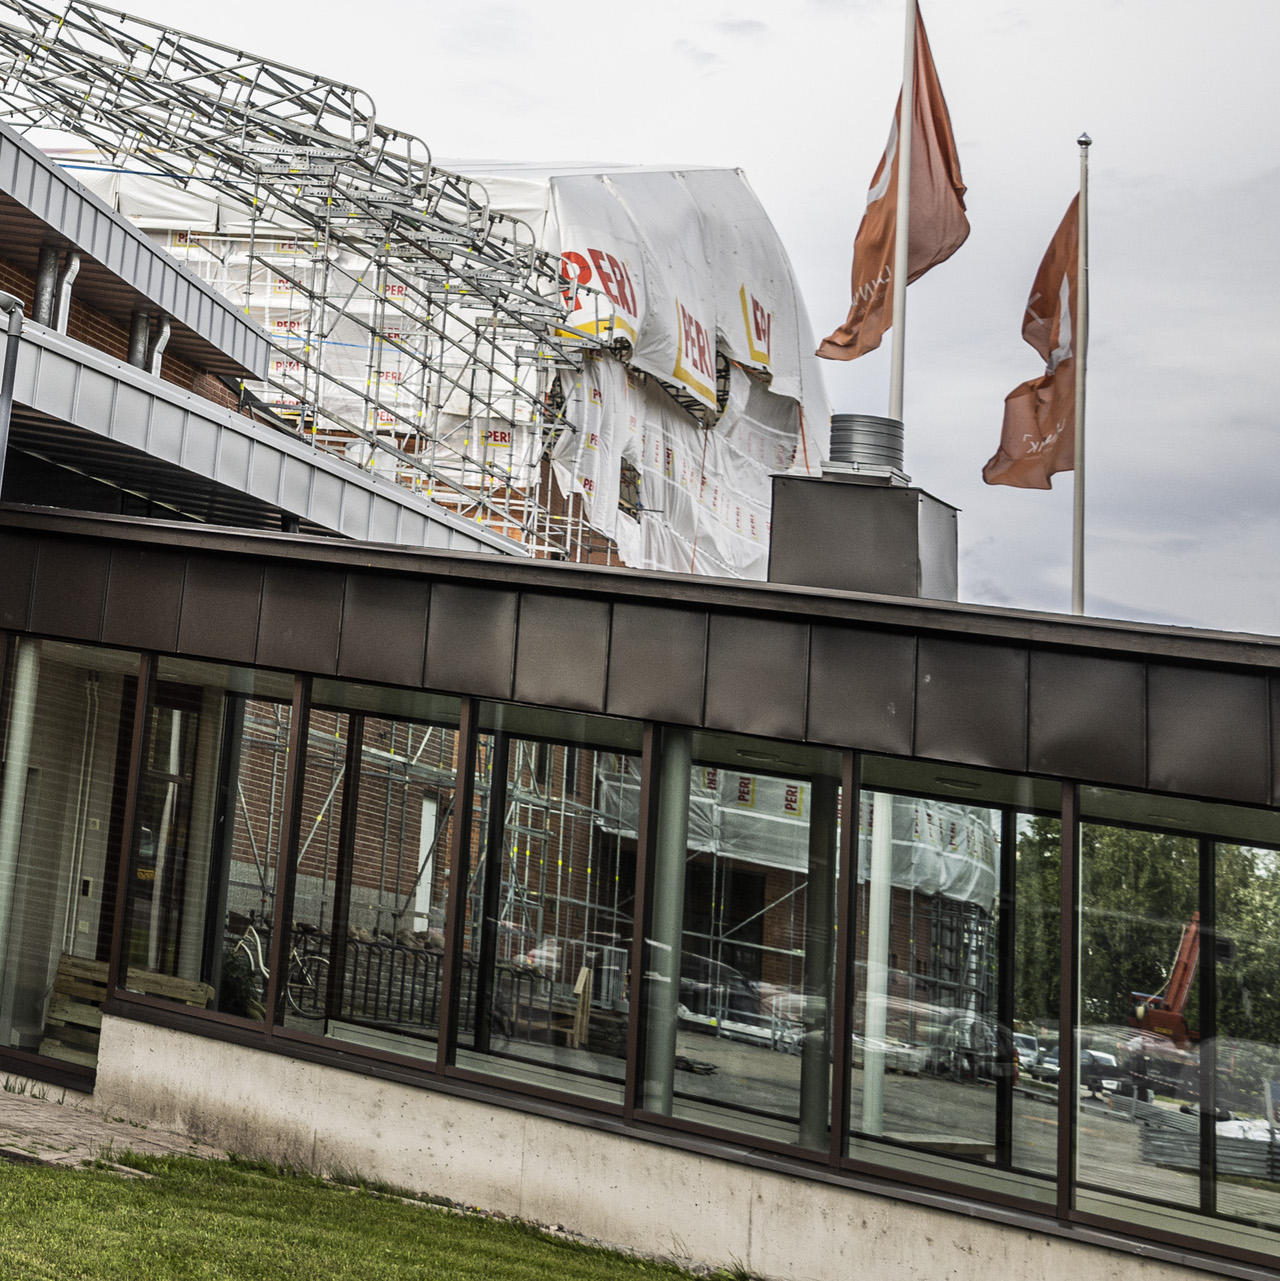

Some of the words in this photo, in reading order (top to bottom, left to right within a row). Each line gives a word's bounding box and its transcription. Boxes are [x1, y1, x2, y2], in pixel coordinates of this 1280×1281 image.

[561, 248, 637, 319] PERI
[680, 303, 715, 383] PERI
[487, 430, 511, 443] PERI
[738, 776, 752, 803] PERI
[784, 784, 799, 812] PERI
